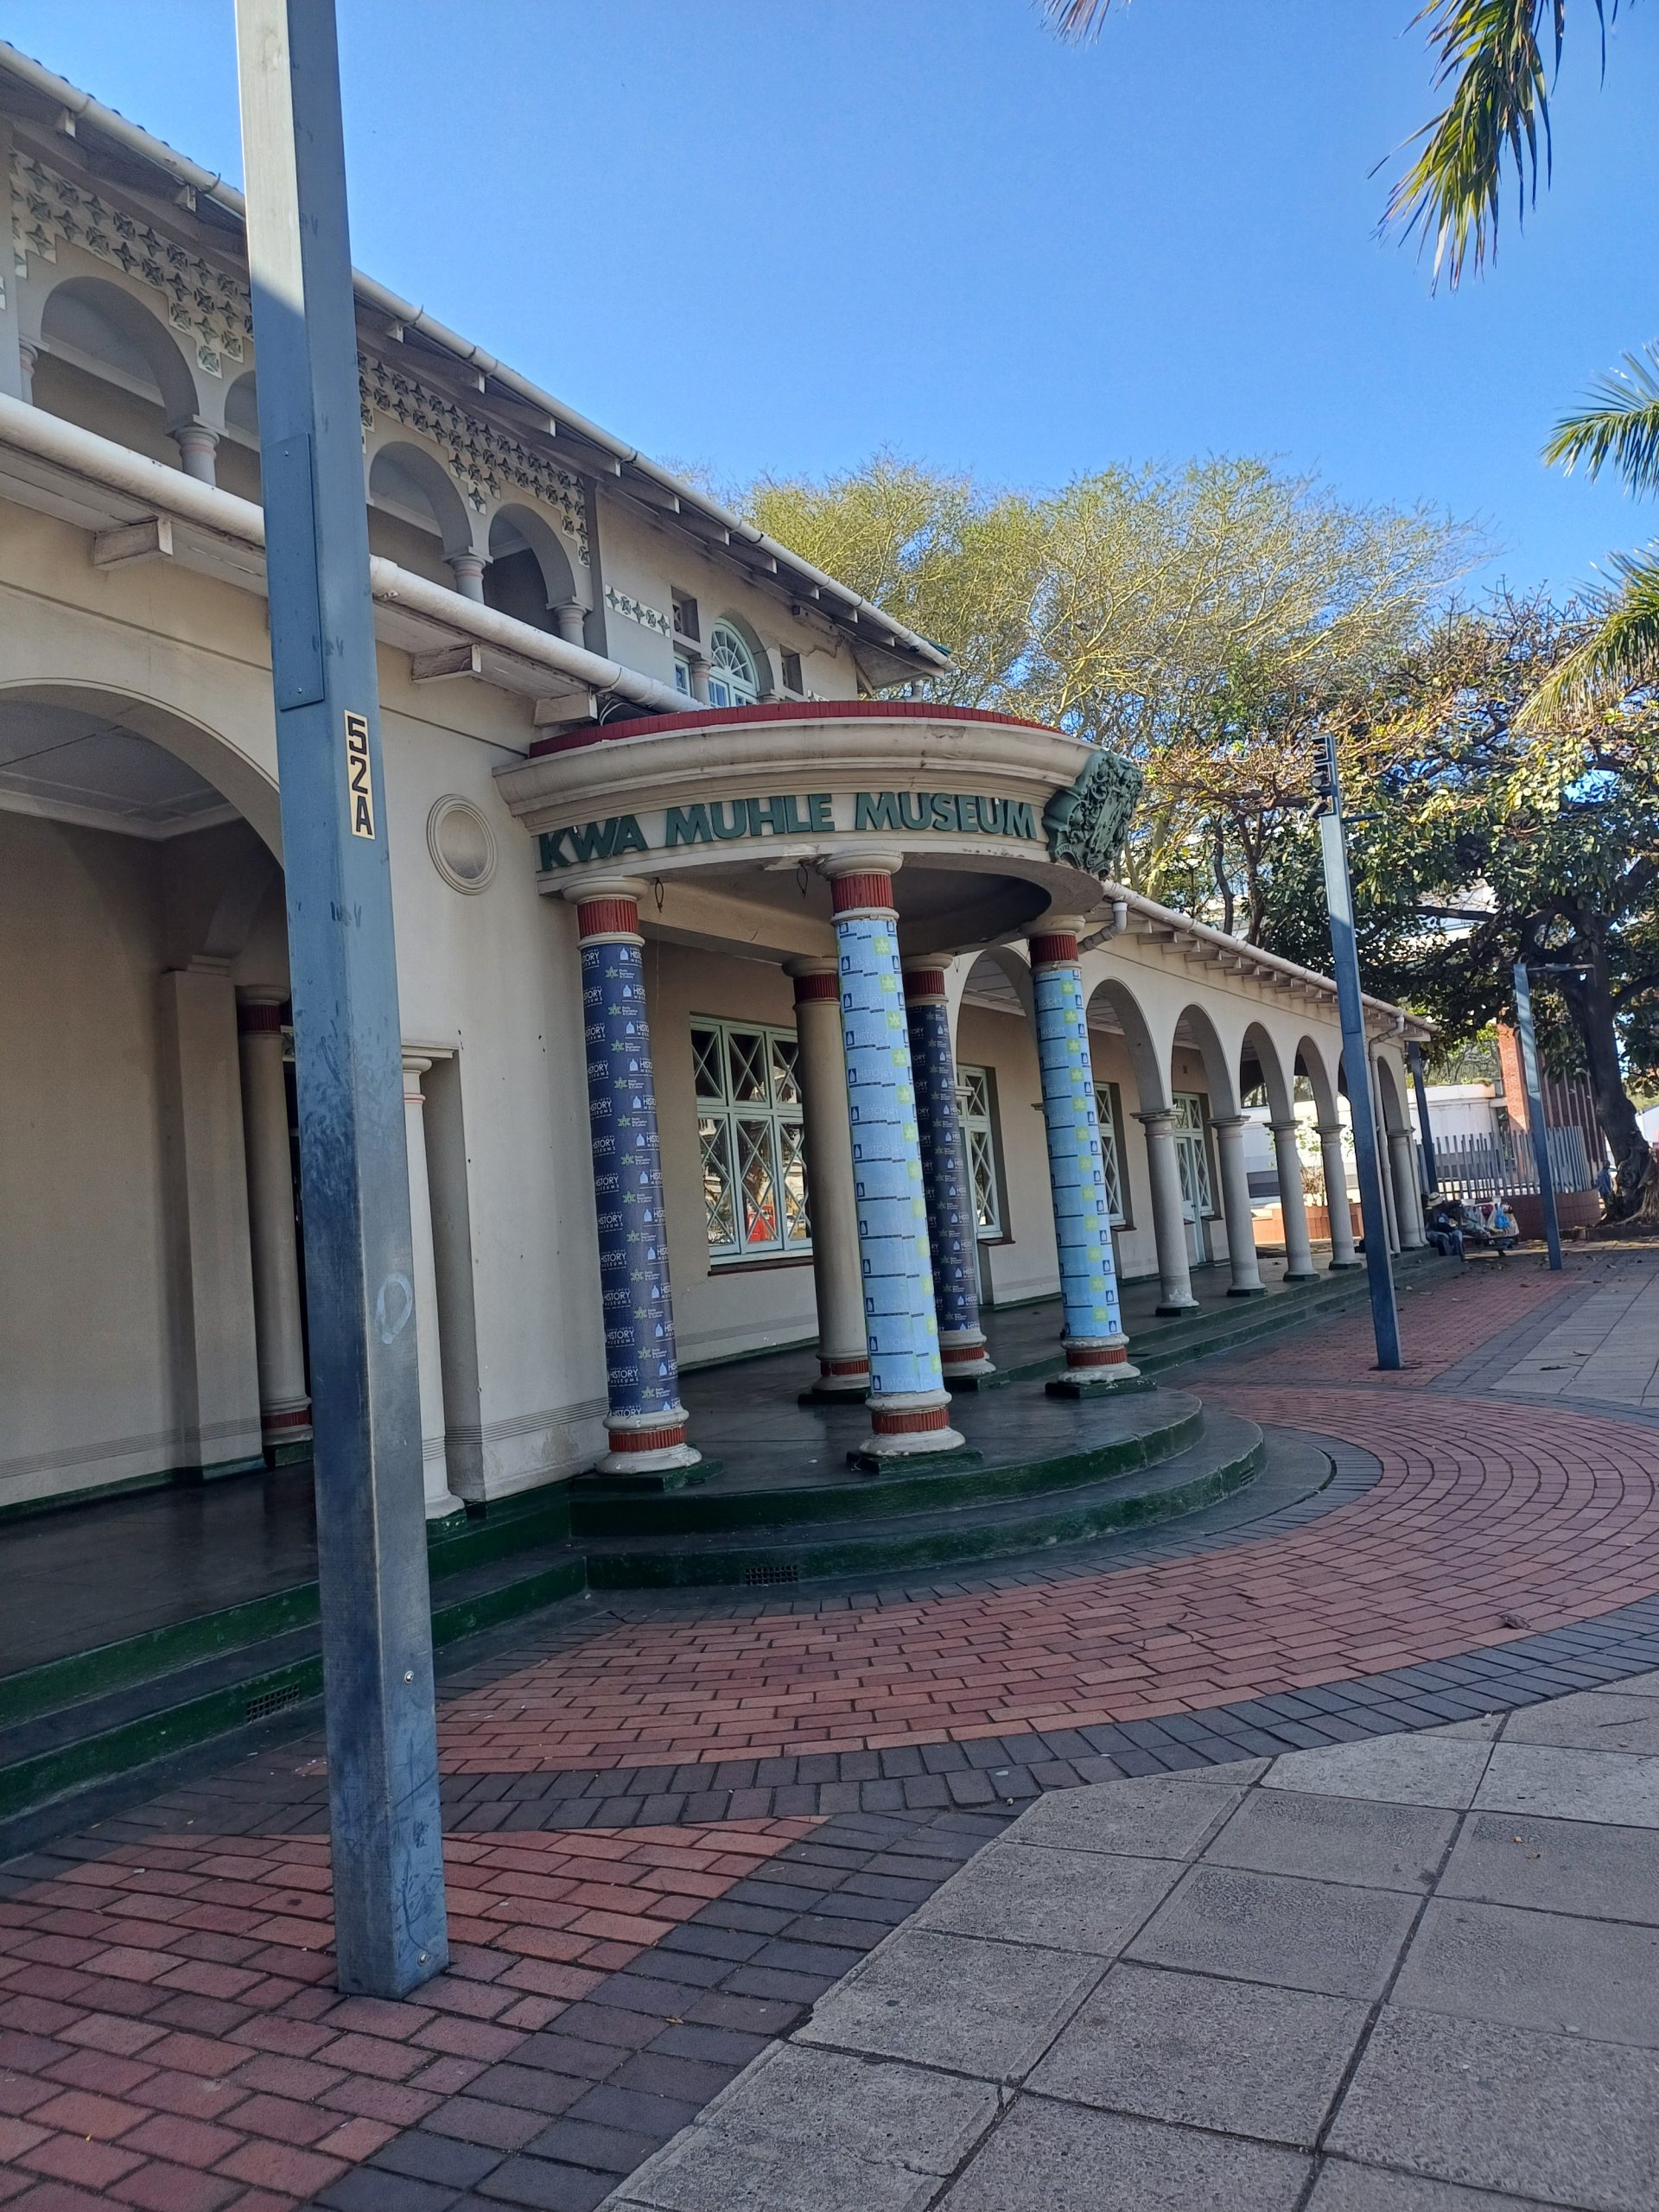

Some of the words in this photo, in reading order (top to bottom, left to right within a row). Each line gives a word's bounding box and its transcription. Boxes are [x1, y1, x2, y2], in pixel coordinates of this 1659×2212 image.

[347, 715, 372, 836] 52A
[538, 814, 648, 871] KWA
[666, 793, 836, 847] MUHLE
[855, 791, 1037, 839] MUSEUM
[607, 1330, 634, 1340] HISTORY
[610, 1369, 639, 1379] HISTORY
